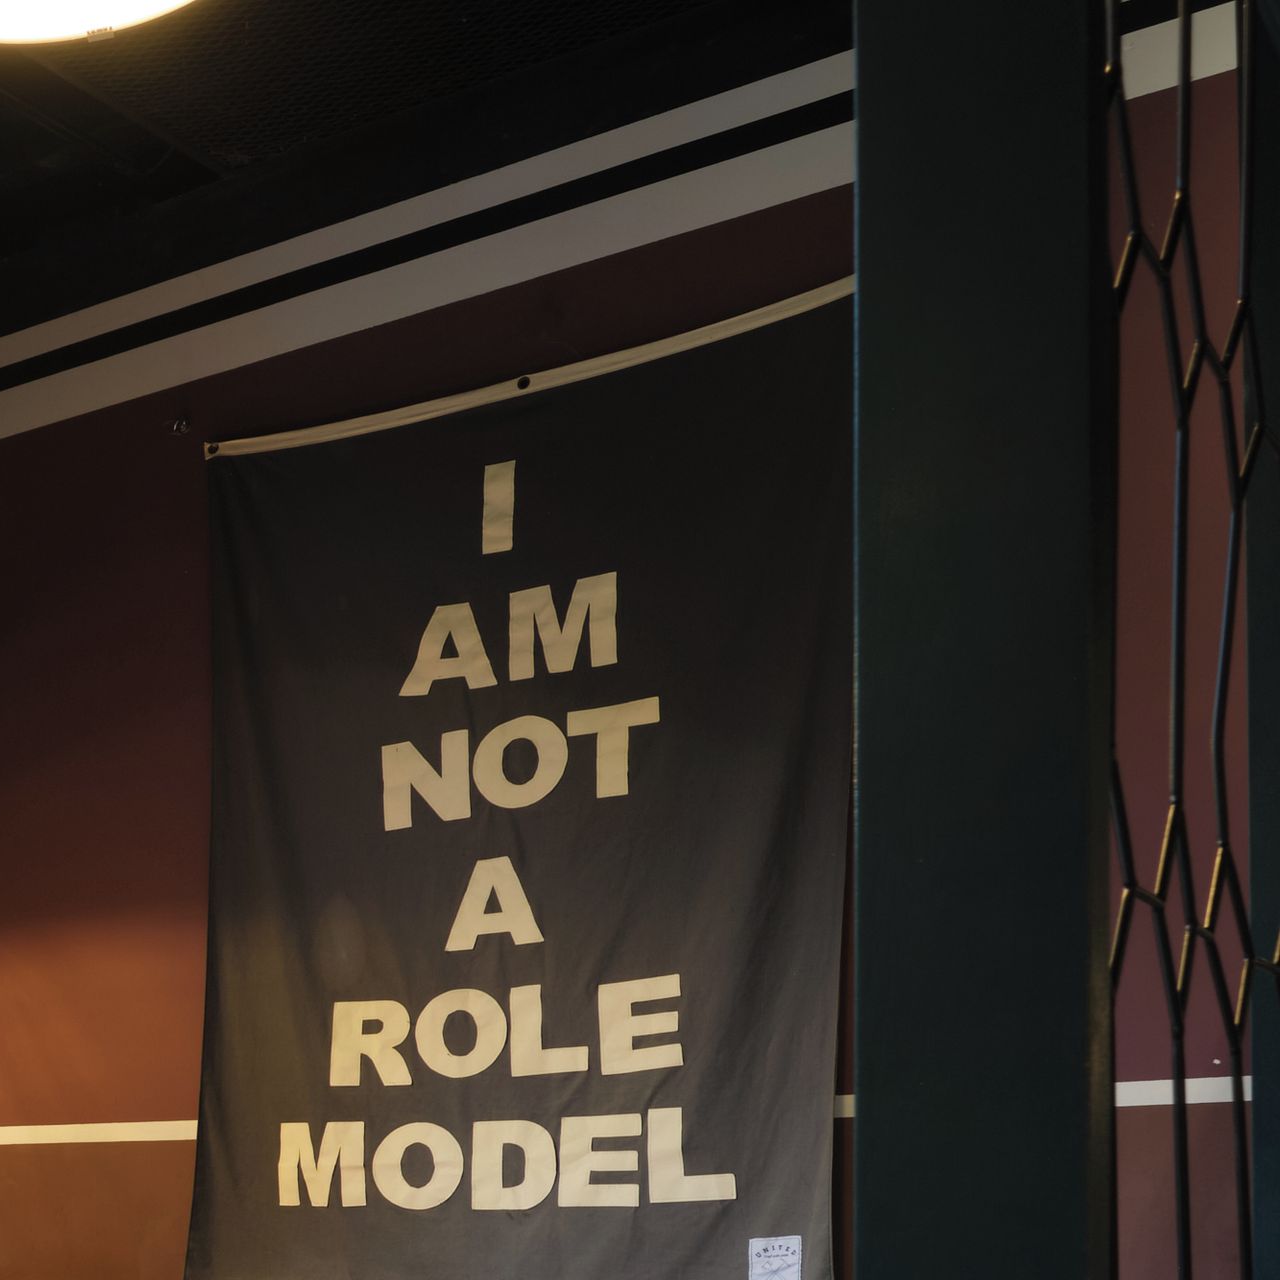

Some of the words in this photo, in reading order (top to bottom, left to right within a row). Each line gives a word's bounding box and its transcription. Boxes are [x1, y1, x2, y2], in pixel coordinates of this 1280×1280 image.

[482, 460, 516, 554] I
[398, 571, 618, 698] AM
[381, 696, 660, 832] NOT
[444, 855, 545, 952] A
[328, 973, 684, 1088] ROLE
[277, 1106, 737, 1211] MODEL
[755, 1244, 797, 1258] UNITED
